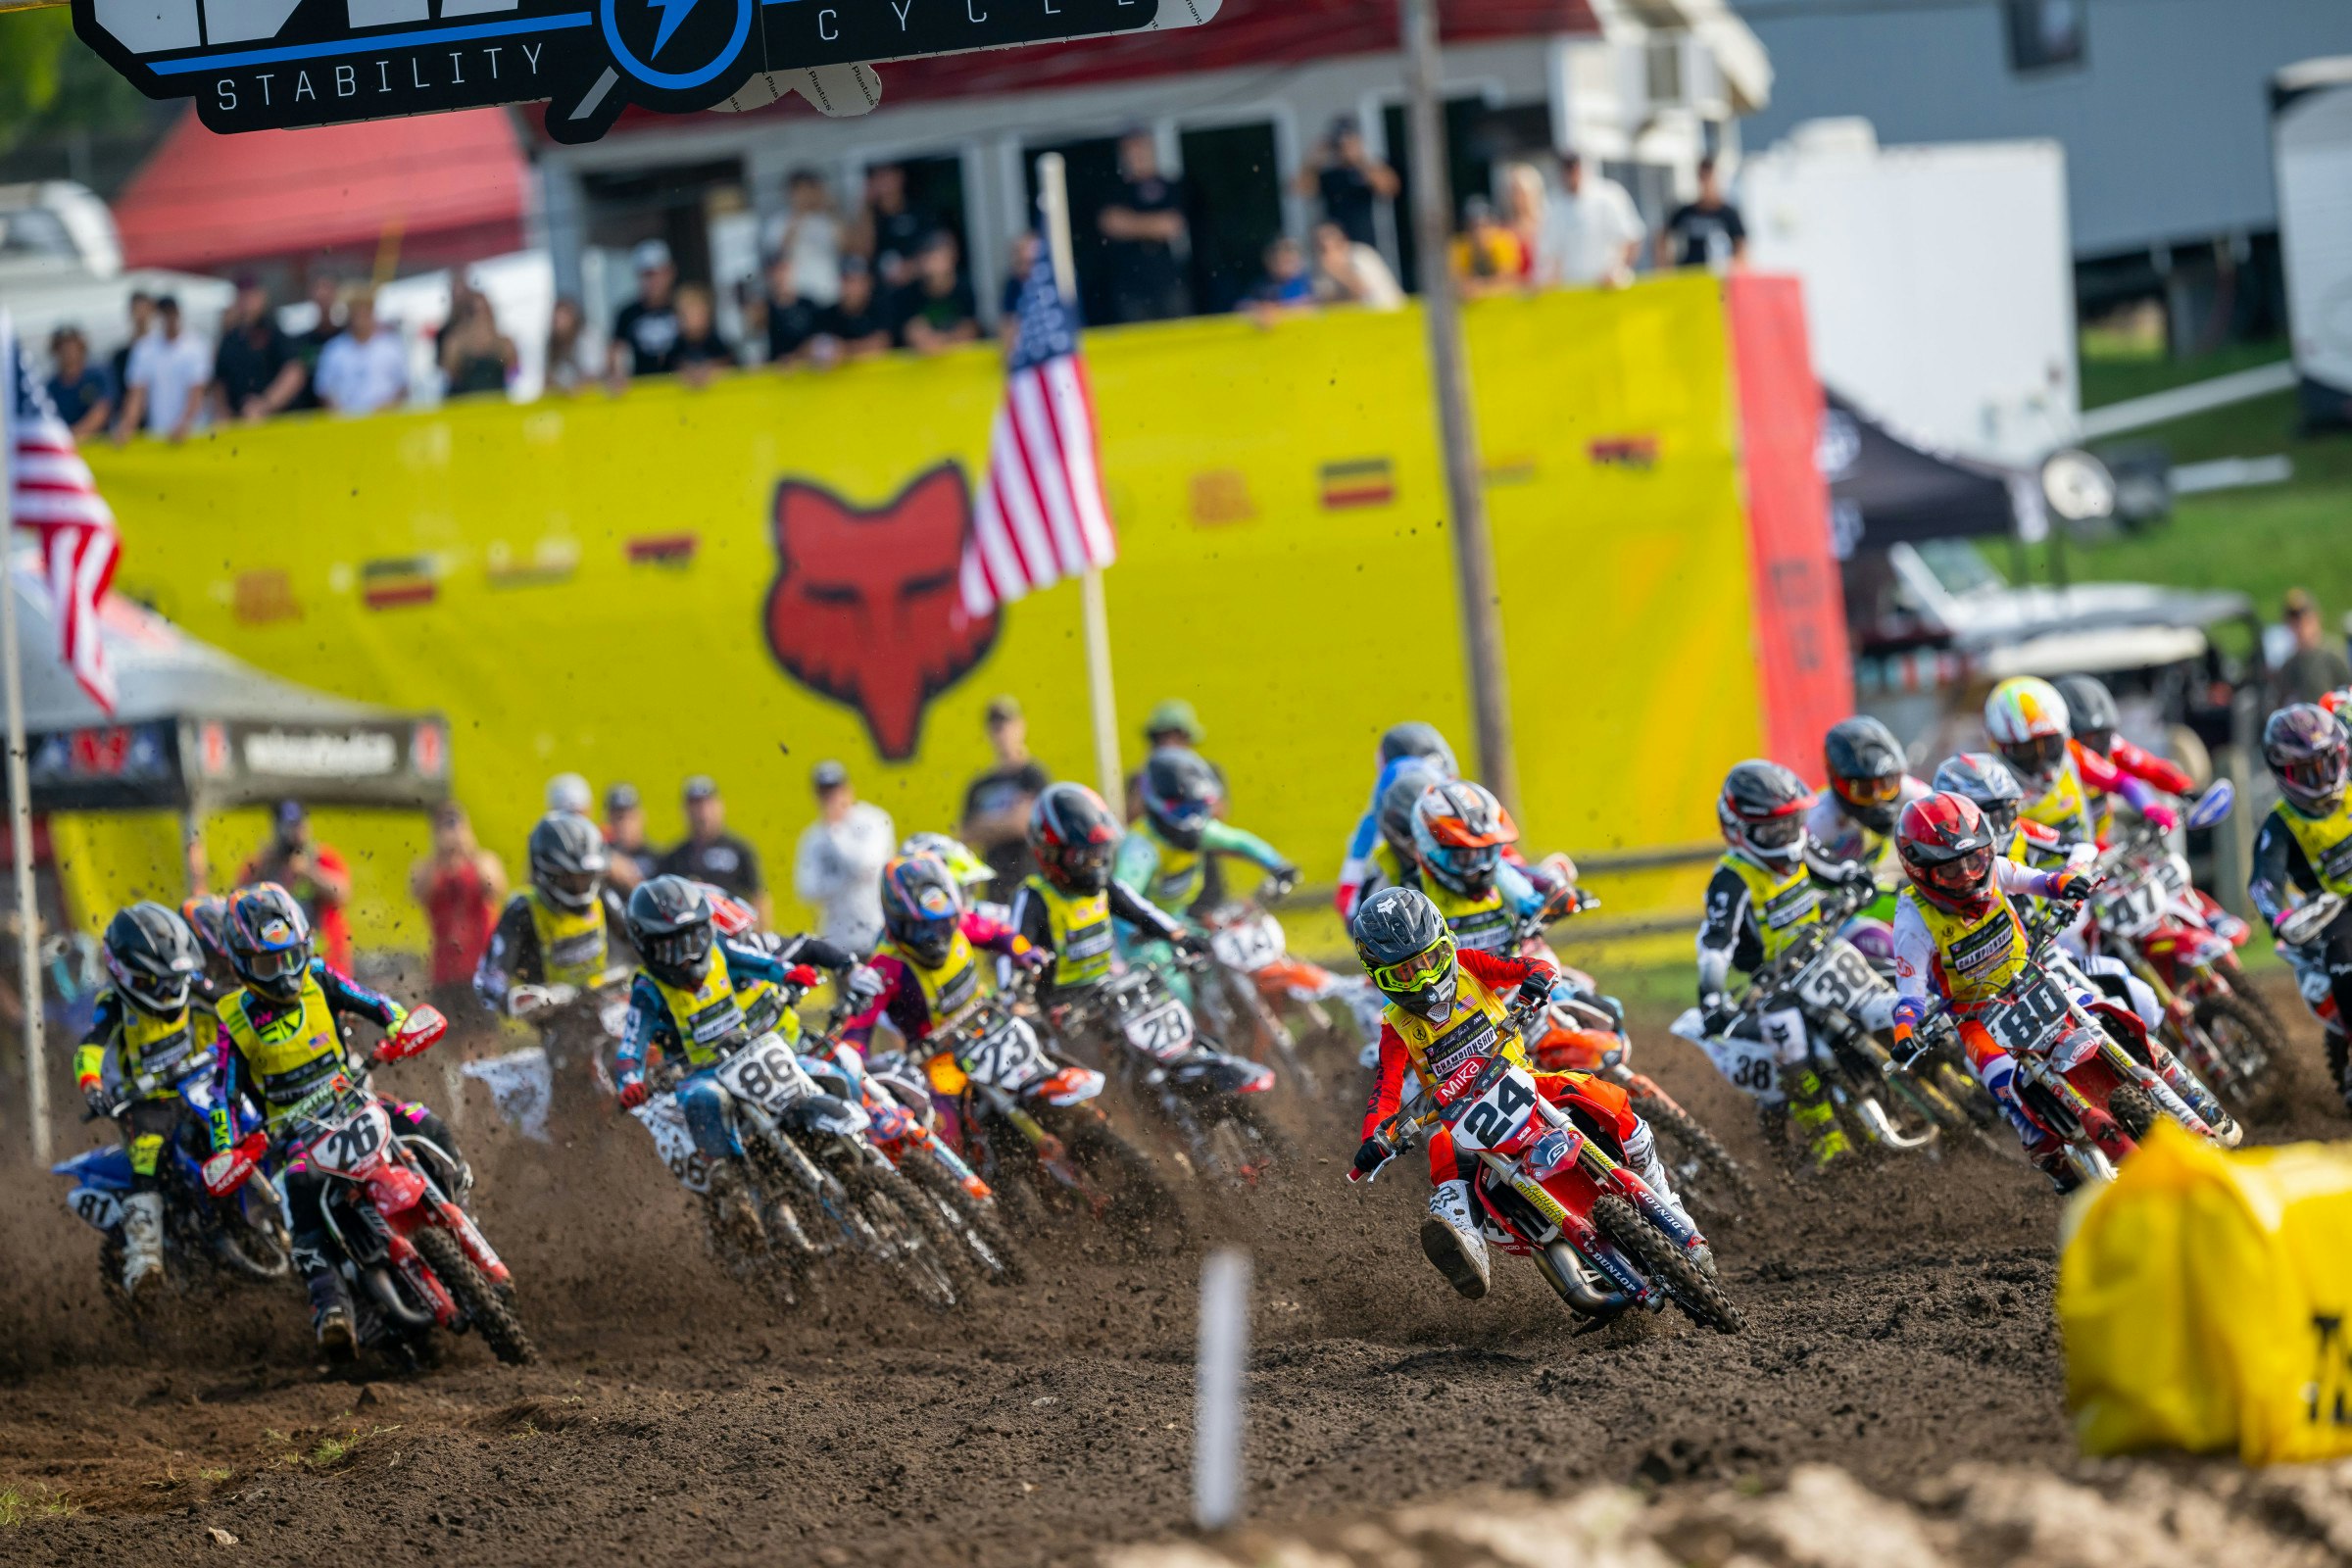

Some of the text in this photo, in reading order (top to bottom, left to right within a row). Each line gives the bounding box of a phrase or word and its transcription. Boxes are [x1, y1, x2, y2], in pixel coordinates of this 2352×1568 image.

[818, 0, 1135, 41] CYC
[1184, 0, 1202, 24] mont
[217, 43, 544, 111] STABILITY
[764, 75, 779, 99] Plas
[2108, 883, 2156, 926] 47
[1814, 952, 1870, 1009] 38
[1143, 1008, 1187, 1052] 28
[2000, 978, 2070, 1049] 80
[739, 1048, 796, 1100] 86
[982, 1029, 1029, 1088] 23
[1435, 1029, 1495, 1075] CHAMPIONSHIP
[1734, 1054, 1771, 1091] 38
[1464, 1074, 1537, 1150] 24
[327, 1113, 379, 1168] 26
[78, 1193, 111, 1225] 81
[1514, 1181, 1564, 1228] connectio
[1638, 1190, 1684, 1231] DUNLOP
[1592, 1250, 1638, 1292] DUNLOP
